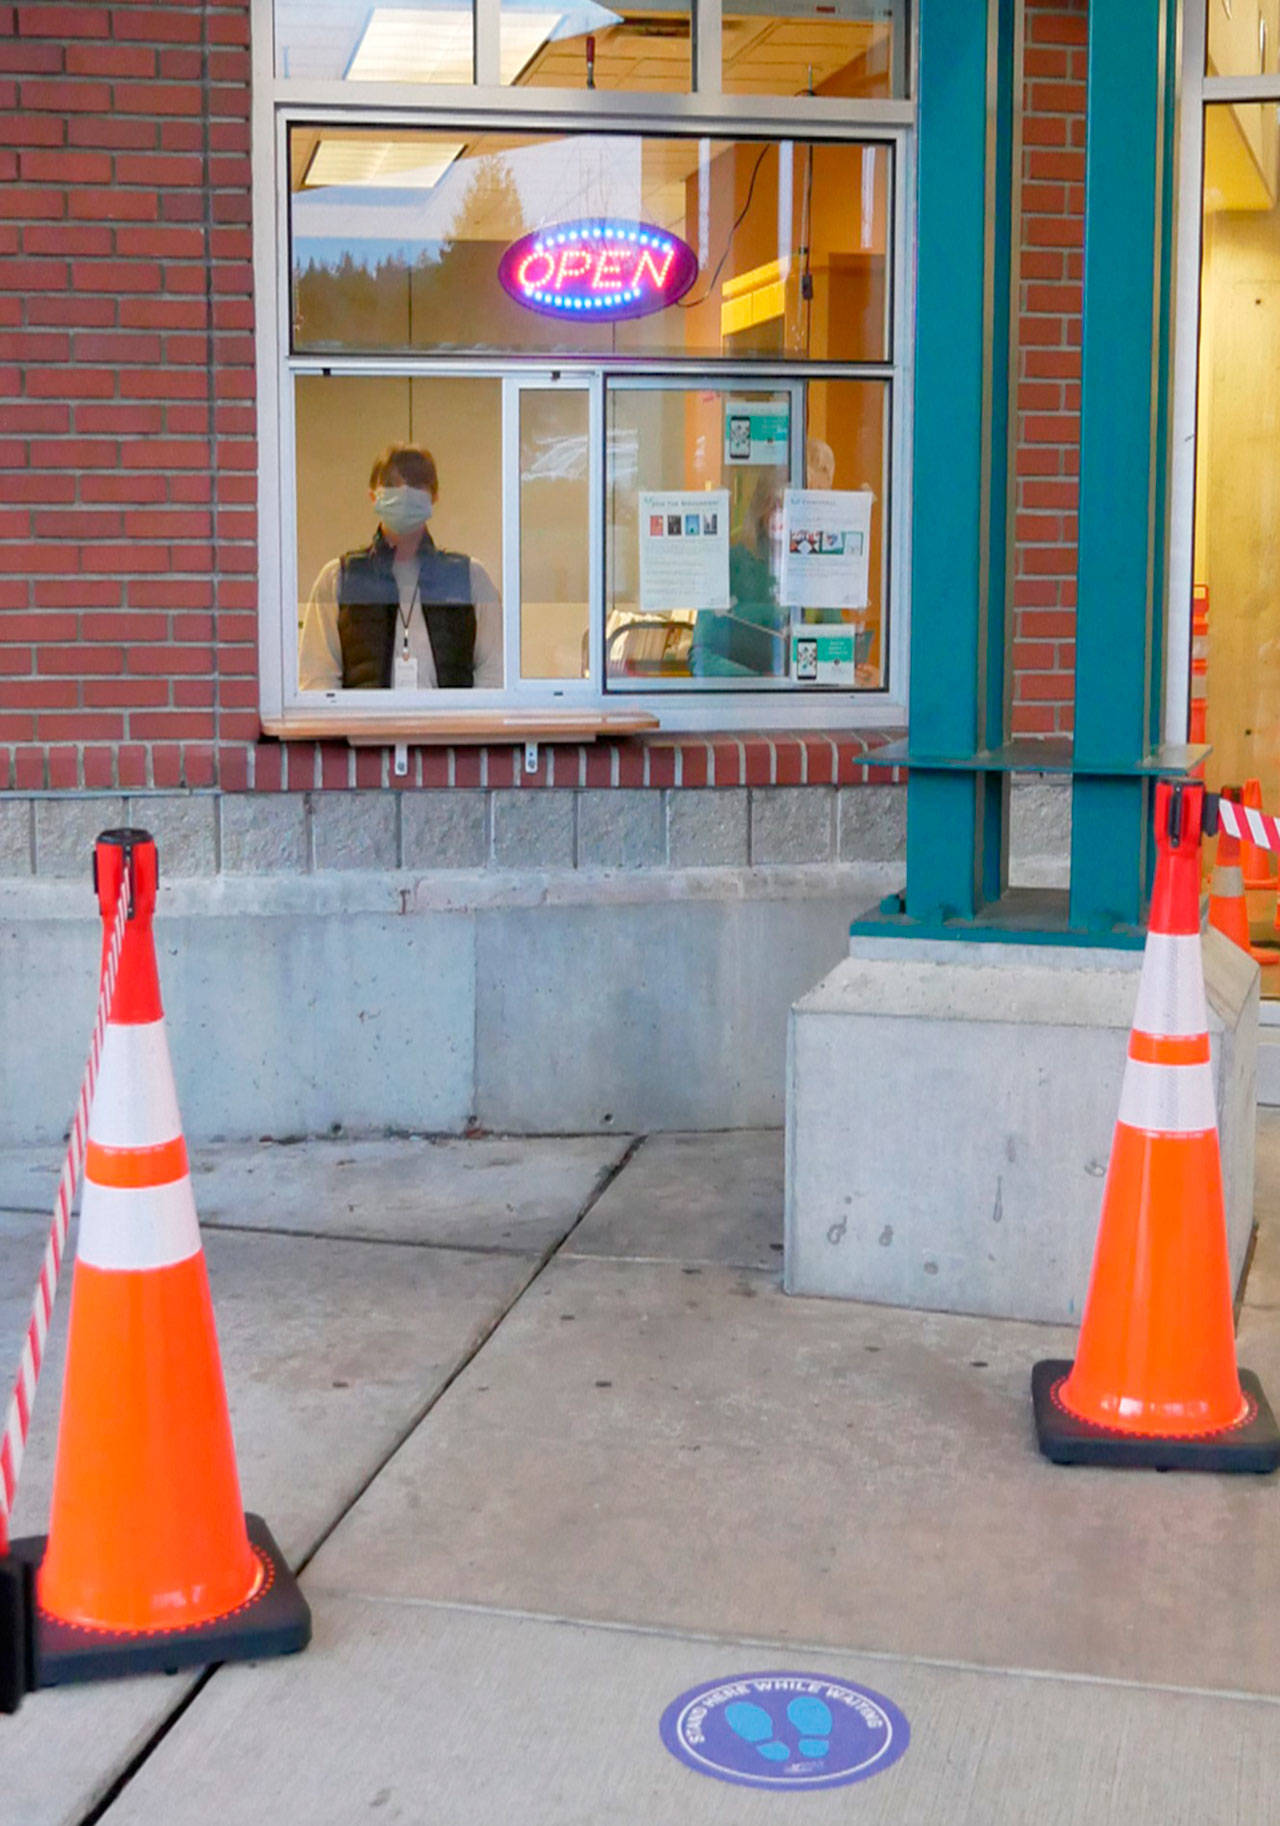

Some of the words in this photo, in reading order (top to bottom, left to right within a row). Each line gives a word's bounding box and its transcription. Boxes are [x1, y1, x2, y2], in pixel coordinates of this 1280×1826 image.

[518, 248, 675, 289] OPEN
[685, 1705, 708, 1745] STAND
[704, 1683, 751, 1707] HERE
[754, 1680, 821, 1694] WHILE
[826, 1687, 883, 1729] WAITING
